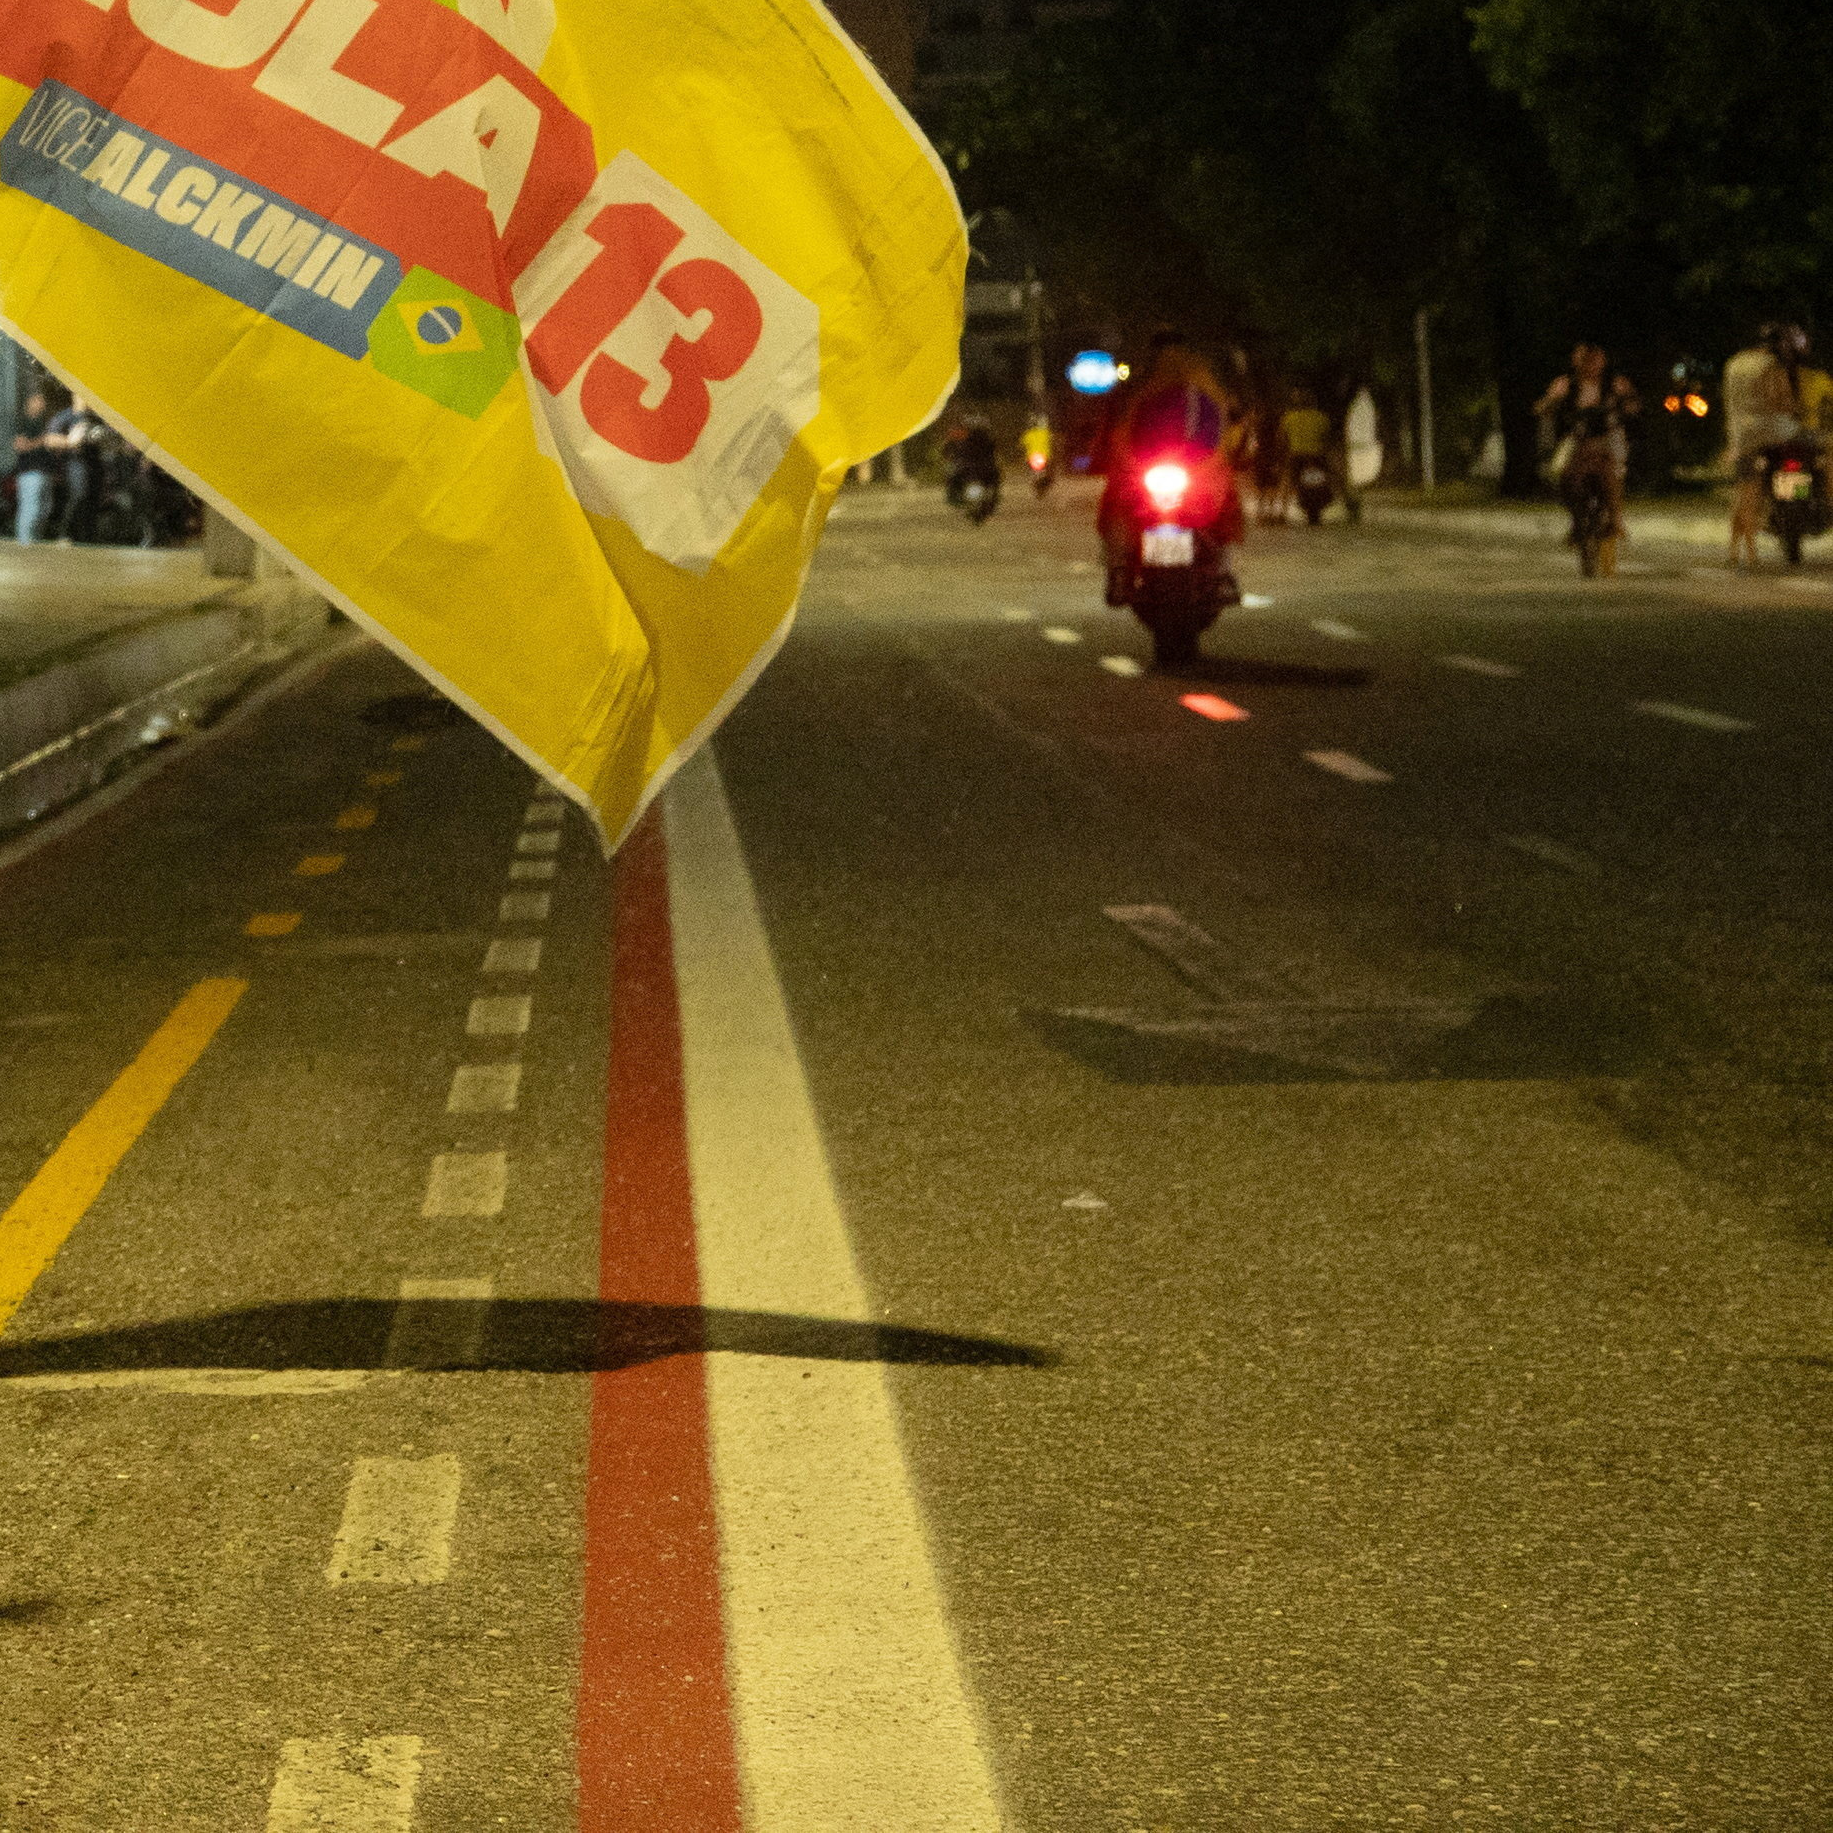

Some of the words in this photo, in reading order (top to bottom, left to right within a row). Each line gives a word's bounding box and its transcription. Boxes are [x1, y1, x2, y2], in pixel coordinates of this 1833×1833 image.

[19, 89, 109, 172] VICE
[80, 130, 384, 311] ALCKMIN
[526, 201, 764, 466] 13
